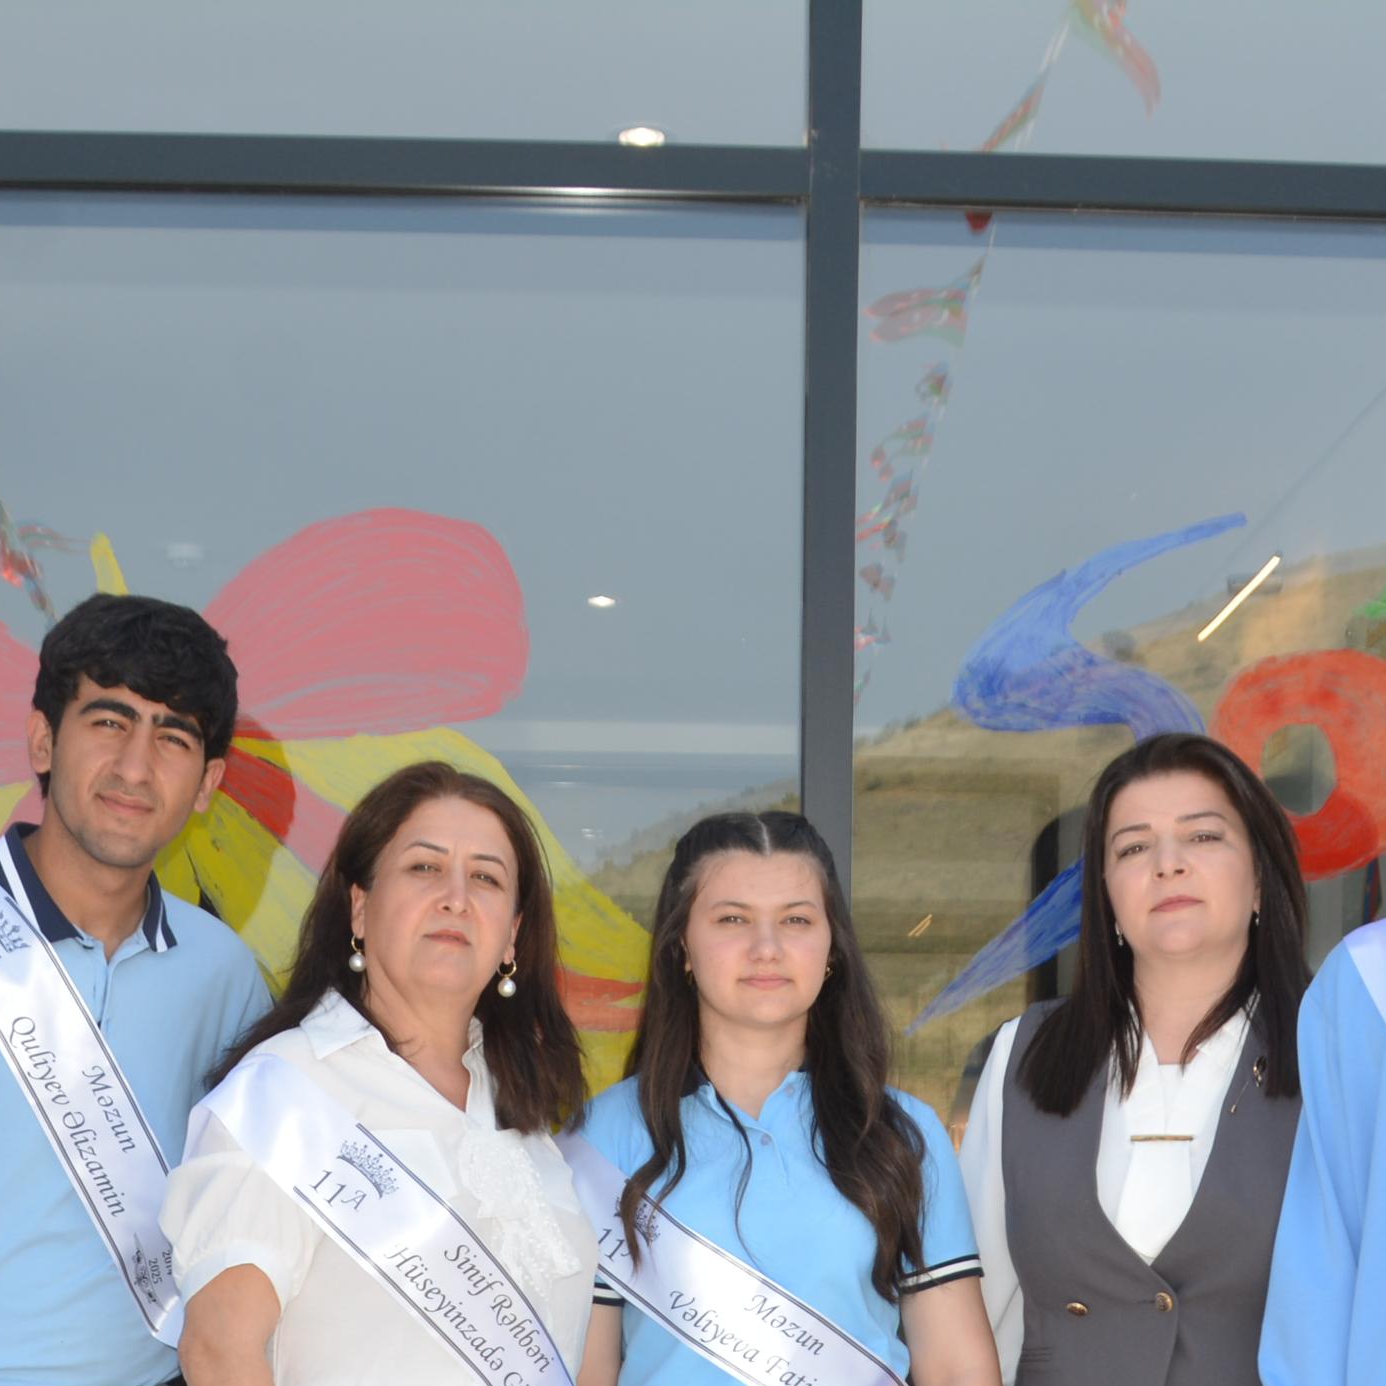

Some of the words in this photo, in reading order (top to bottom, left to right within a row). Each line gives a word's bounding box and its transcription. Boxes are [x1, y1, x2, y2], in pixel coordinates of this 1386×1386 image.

[9, 1016, 70, 1107] Quliyev
[62, 1111, 126, 1218] Əlizamin
[82, 1065, 137, 1154] Məzun
[309, 1168, 368, 1212] 11A
[148, 1257, 163, 1285] 2025
[598, 1228, 631, 1263] 11
[383, 1243, 504, 1372] Hüseyinzadə
[443, 1243, 505, 1297] Sinif
[489, 1293, 555, 1374] Rəhbəri
[669, 1289, 761, 1363] Vəliyeva
[743, 1294, 825, 1356] Məzun
